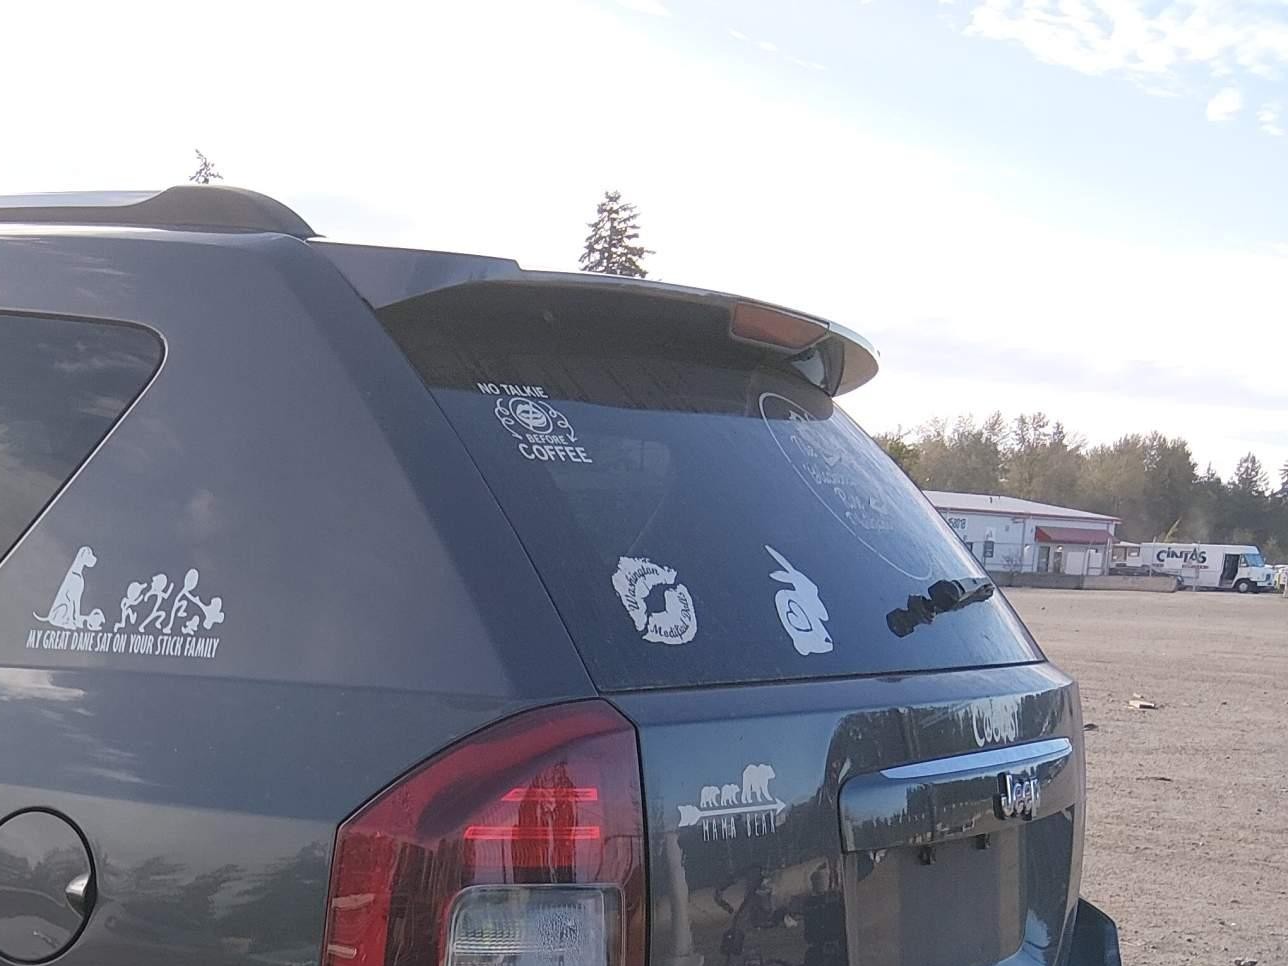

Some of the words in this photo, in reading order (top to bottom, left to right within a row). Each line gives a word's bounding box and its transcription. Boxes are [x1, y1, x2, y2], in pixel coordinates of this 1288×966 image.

[477, 382, 500, 395] NO
[500, 384, 549, 399] TALKIE
[518, 443, 593, 463] COFFEE
[525, 433, 569, 445] BEFORE
[624, 565, 660, 611] Washington
[26, 630, 43, 649] MY
[42, 630, 69, 650] GREAT
[70, 632, 95, 651] DANE
[95, 633, 112, 652] SAT
[112, 634, 128, 653] ON
[129, 634, 155, 655] YOUR
[155, 636, 184, 656] STICK
[184, 637, 221, 658] FAMILY
[999, 774, 1040, 818] Jeep
[702, 816, 737, 841] MAMA
[746, 810, 776, 838] BEAR
